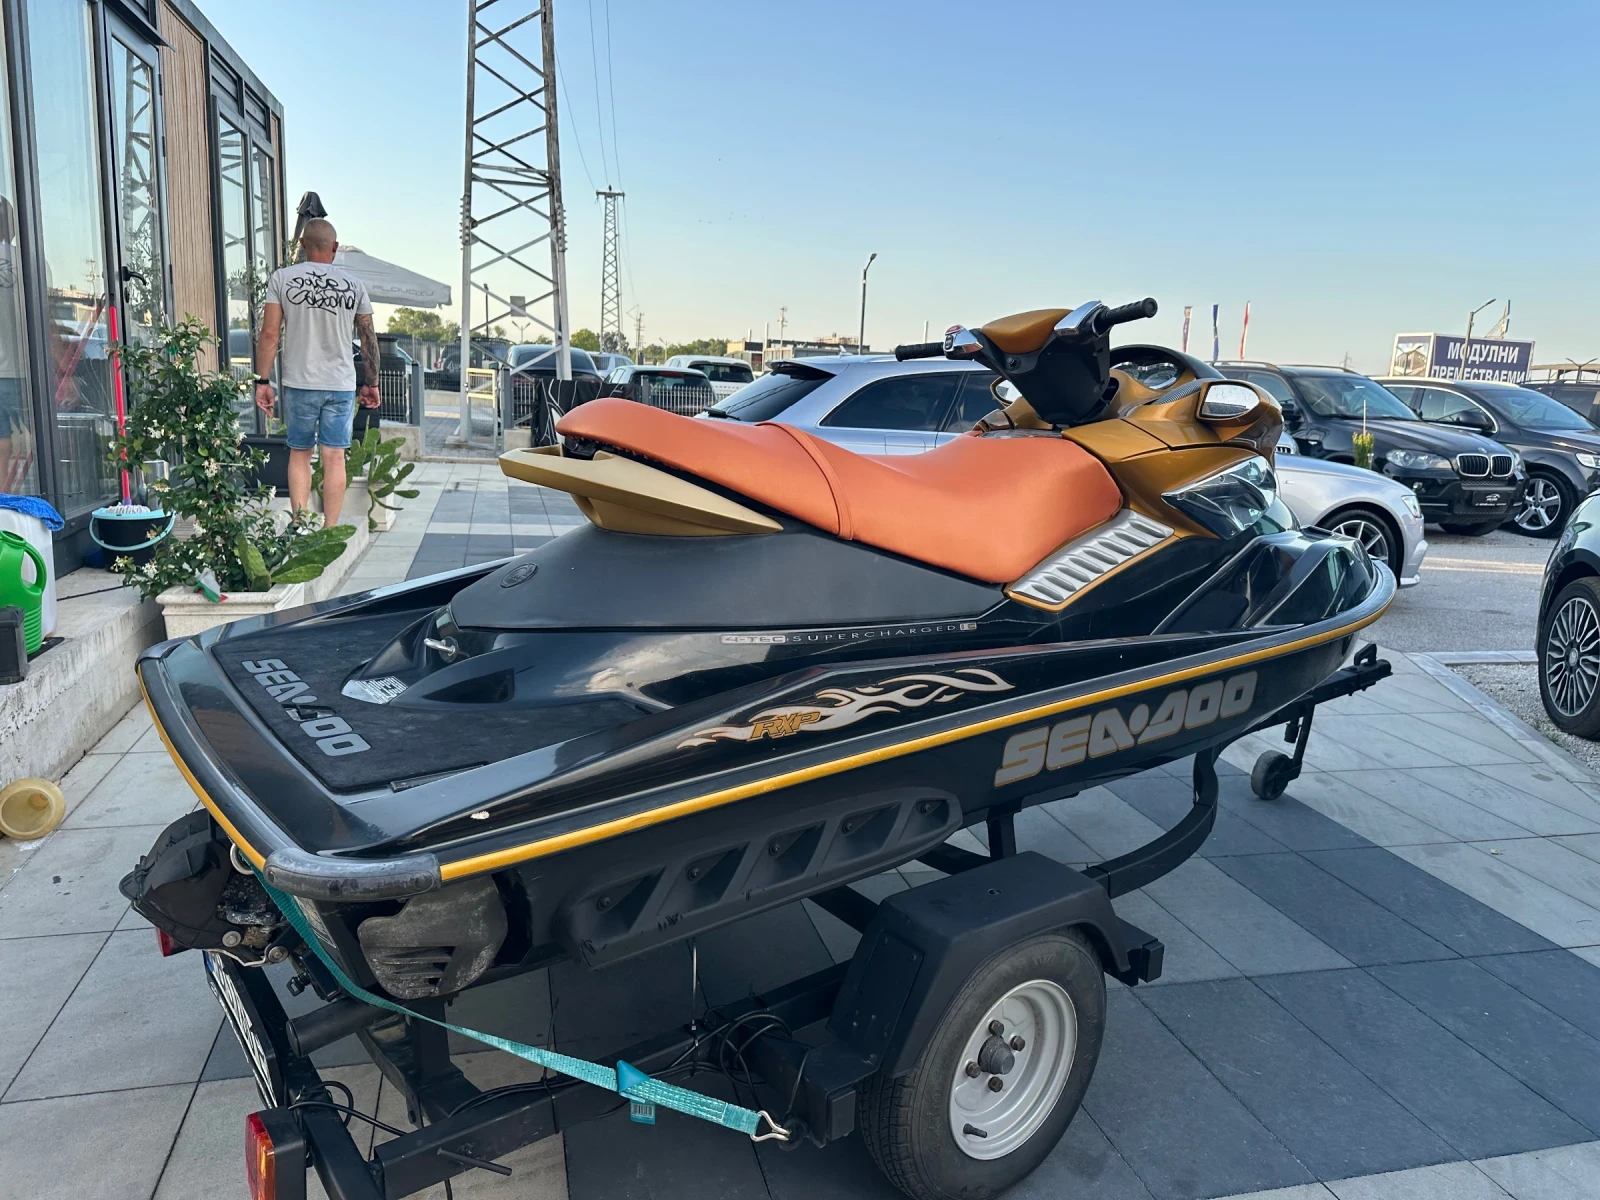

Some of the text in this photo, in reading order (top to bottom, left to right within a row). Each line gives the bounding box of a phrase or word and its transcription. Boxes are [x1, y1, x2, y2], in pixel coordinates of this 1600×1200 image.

[1447, 342, 1519, 364] МОДУЛНИ
[793, 624, 956, 642] SUPERCHARGED
[747, 711, 821, 742] RXP
